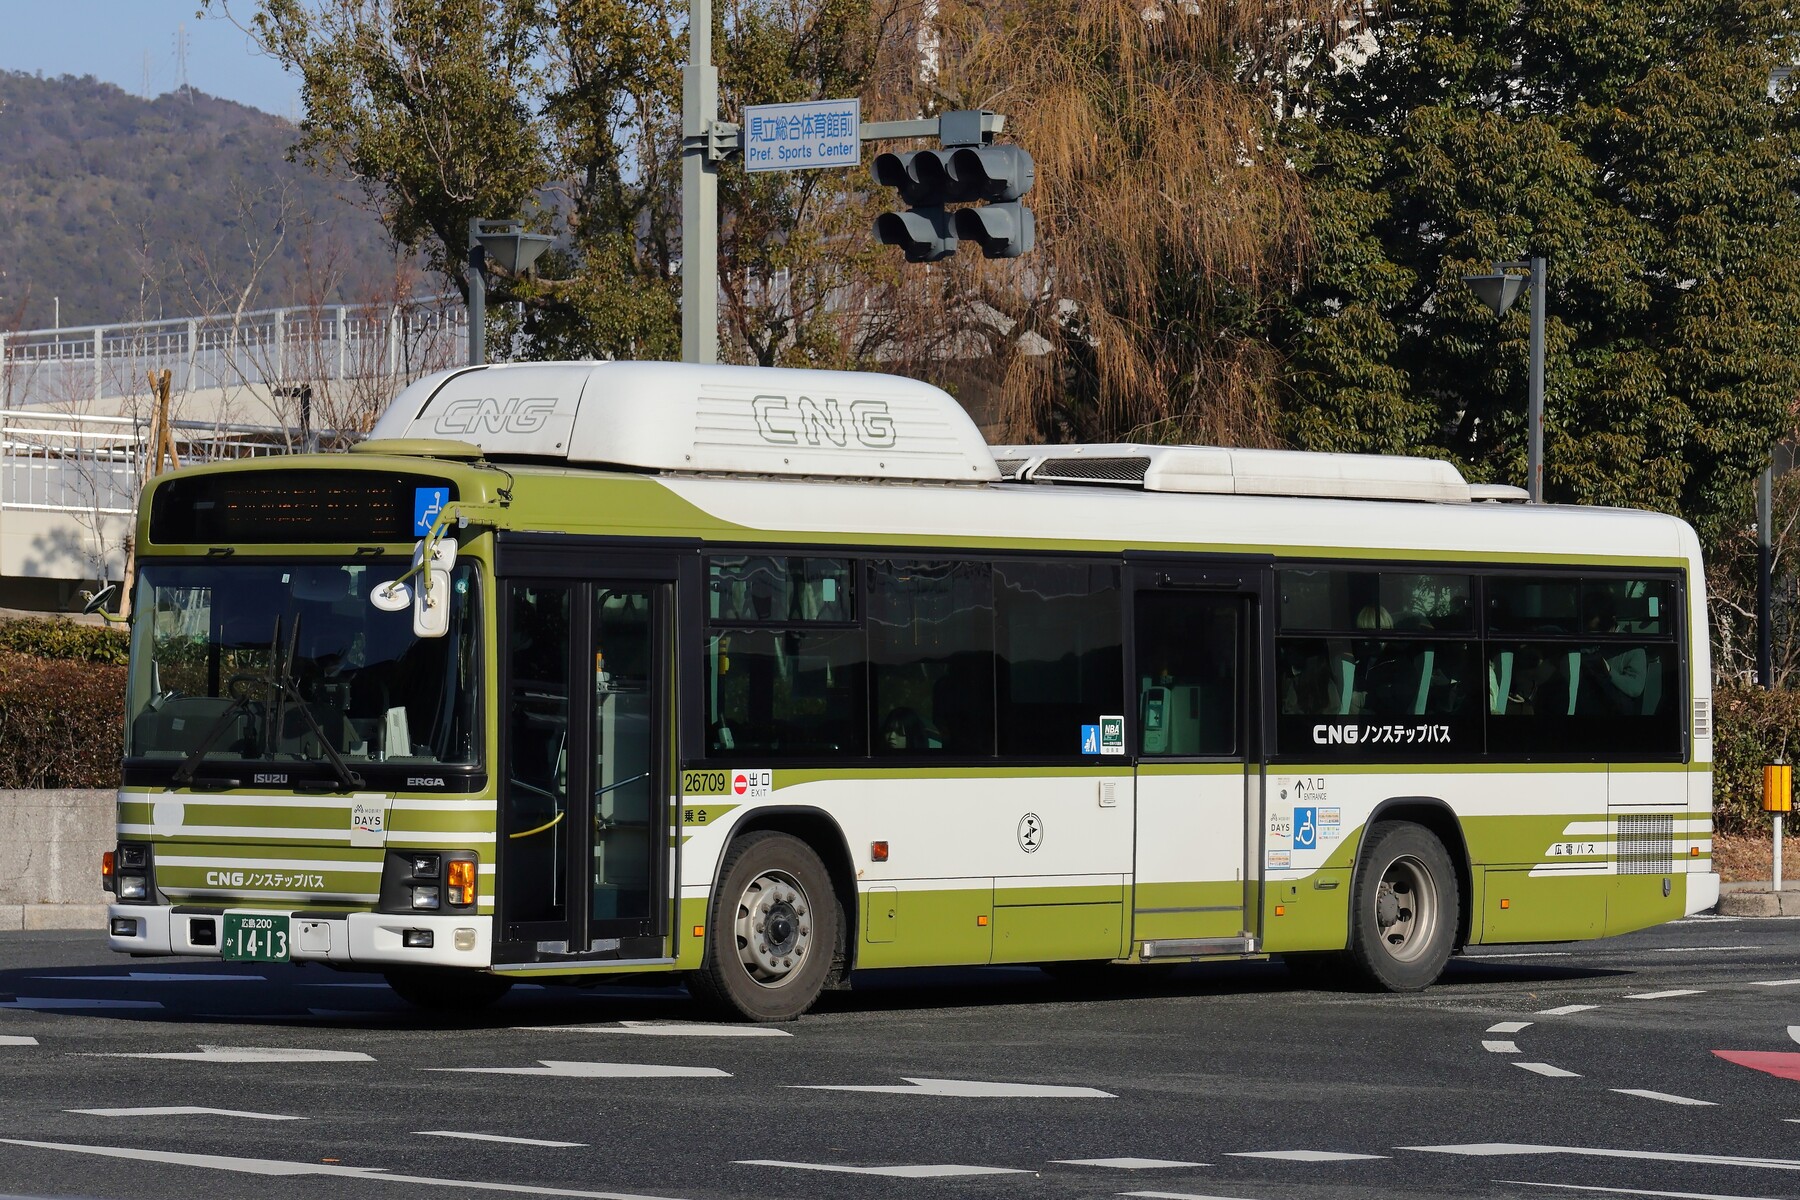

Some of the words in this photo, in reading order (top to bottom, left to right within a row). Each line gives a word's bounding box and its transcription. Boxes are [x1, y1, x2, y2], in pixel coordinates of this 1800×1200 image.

[750, 111, 853, 142] 県立総合体育館前
[750, 147, 774, 161] Pref.
[778, 145, 812, 162] Sports
[818, 142, 854, 157] Center
[434, 397, 558, 434] CNG
[752, 395, 896, 448] CNG
[1105, 724, 1120, 735] NBA
[254, 773, 288, 784] ISUZU
[406, 777, 445, 786] ERGA
[685, 773, 725, 792] 26709
[749, 773, 769, 786] 出口
[1306, 778, 1324, 790] 入口
[751, 789, 767, 797] EXIT
[354, 816, 381, 825] DAYS
[684, 809, 707, 822] 乗合
[1271, 823, 1290, 832] DAYS
[1554, 844, 1594, 856] 広電バス
